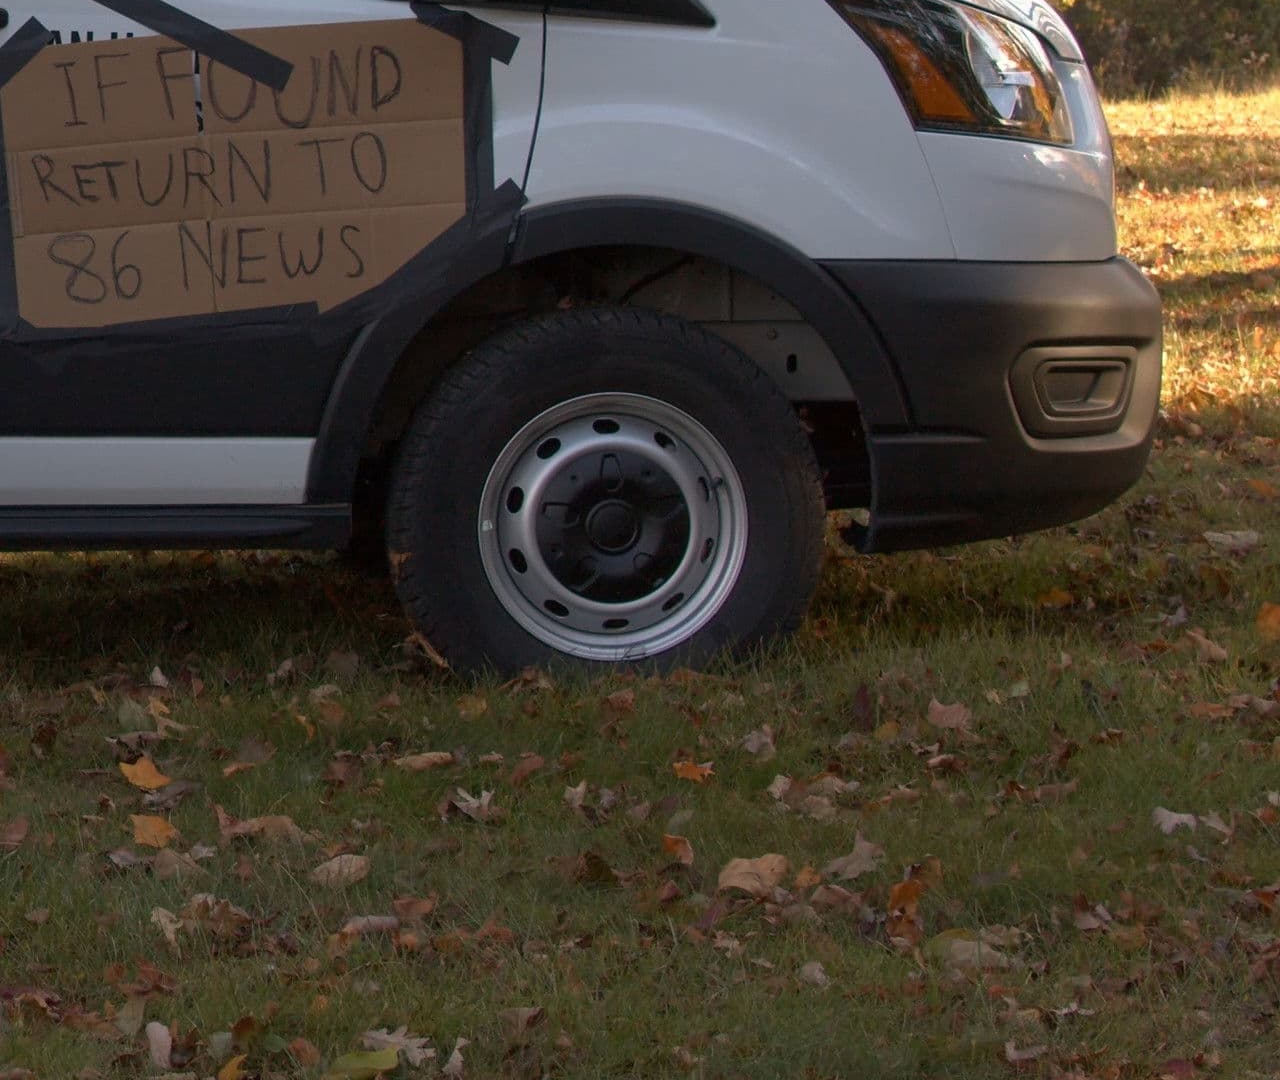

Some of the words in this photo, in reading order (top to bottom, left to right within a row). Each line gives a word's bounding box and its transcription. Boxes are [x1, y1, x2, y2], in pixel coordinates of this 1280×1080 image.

[53, 53, 130, 126] IF
[155, 45, 402, 129] FOUND
[30, 139, 273, 209] RETURN
[295, 131, 388, 193] TO
[48, 231, 141, 304] 86
[177, 219, 365, 290] NEWS
